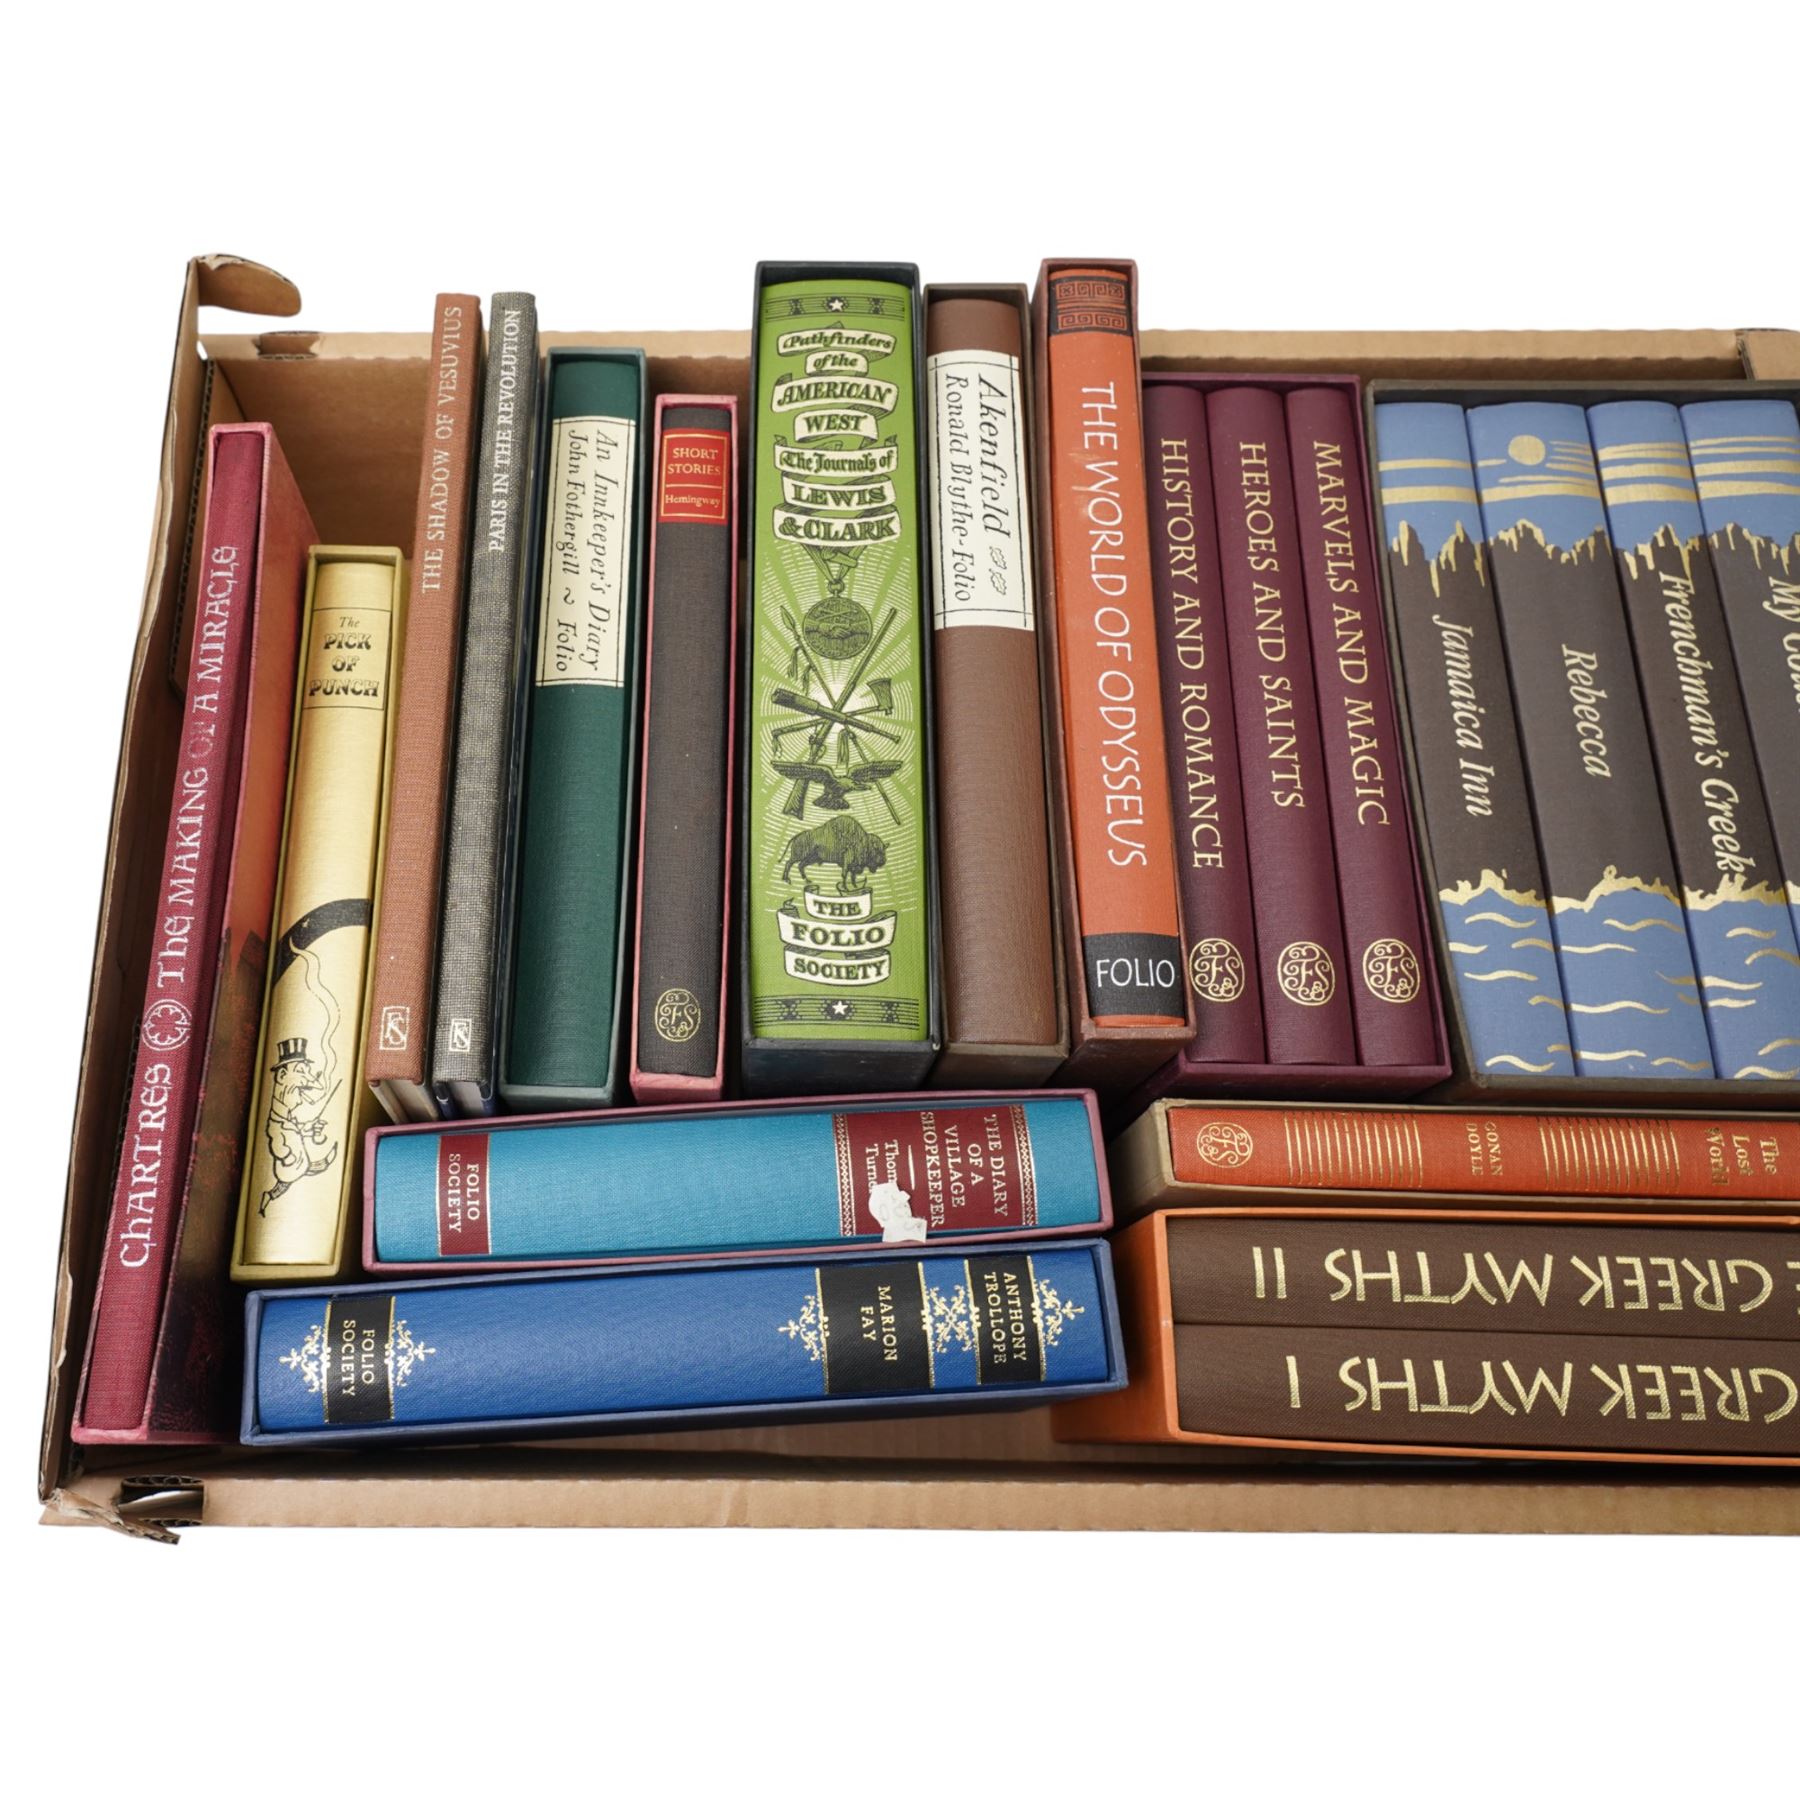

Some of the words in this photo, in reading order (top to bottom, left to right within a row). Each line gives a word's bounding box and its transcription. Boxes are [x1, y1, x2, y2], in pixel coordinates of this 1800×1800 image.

[438, 306, 463, 406] VESUVIUS
[497, 309, 521, 428] REVOLUTION
[782, 331, 892, 350] Pathfinders
[813, 355, 831, 370] of
[829, 354, 858, 367] the
[777, 381, 892, 407] AMERICAN
[945, 374, 970, 455] Ronald
[1081, 381, 1118, 450] THE
[436, 417, 455, 441] OF
[494, 429, 512, 468] THE
[597, 430, 618, 462] An
[802, 414, 868, 432] WEST
[568, 429, 588, 474] John
[667, 464, 721, 476] STORIES
[673, 448, 718, 460] SHORT
[780, 449, 812, 470] The
[813, 451, 877, 474] Journals
[879, 448, 893, 468] of
[978, 373, 1011, 538] Akenfield
[427, 448, 451, 541] SHADOW
[492, 472, 509, 495] IN
[665, 494, 720, 508] Hemingway
[792, 484, 886, 506] LEWIS
[1161, 438, 1198, 584] HISTORY
[1240, 441, 1280, 572] HEROES
[489, 500, 508, 552] PARIS
[556, 479, 586, 576] Fothergill
[587, 470, 619, 594] Innkeeper's
[1085, 461, 1127, 596] WORLD
[1313, 441, 1359, 593] MARVELS
[422, 548, 443, 594] THE
[197, 546, 239, 682] MIRACLE
[323, 632, 372, 650] PICK
[339, 616, 360, 628] The
[579, 600, 611, 671] Diary
[1094, 607, 1132, 661] OF
[1173, 592, 1205, 670] AND
[1253, 581, 1286, 662] AND
[332, 655, 360, 672] OF
[556, 619, 577, 672] Folio
[1332, 603, 1368, 685] AND
[192, 691, 219, 713] A
[309, 679, 379, 697] PUNCH
[1432, 614, 1485, 750] Jamaica
[1459, 757, 1495, 817] Inn
[1561, 643, 1612, 778] Rebecca
[1258, 674, 1306, 808] SAINTS
[1659, 570, 1731, 769] Frenchman's
[1700, 778, 1756, 874] Creek
[1098, 670, 1147, 866] ODYSSEUS
[1180, 682, 1225, 869] ROMANCE
[1344, 696, 1391, 826] MAGIC
[168, 767, 210, 906] MAKING
[791, 922, 885, 946] FOLIO
[813, 900, 861, 917] THE
[794, 959, 886, 980] SOCIETY
[1096, 958, 1175, 988] FOLIO
[967, 1143, 983, 1168] OF
[984, 1114, 1002, 1151] THE
[1465, 1123, 1484, 1176] DOYLE
[1484, 1121, 1503, 1176] CONAN
[1705, 1127, 1730, 1186] World
[1732, 1134, 1754, 1176] Lost
[1760, 1136, 1779, 1175] The
[865, 1143, 879, 1193] Turne
[885, 1139, 899, 1183] Thom
[920, 1112, 945, 1228] SHOPKEEPER
[944, 1125, 966, 1208] VILLAGE
[970, 1172, 984, 1186] A
[990, 1156, 1008, 1216] DIARY
[448, 1153, 461, 1233] SOCIETY
[467, 1163, 480, 1221] FOLIO
[1251, 1246, 1287, 1299] II
[1324, 1248, 1555, 1307] MYTHS
[1570, 1256, 1774, 1313] GREEK
[861, 1305, 876, 1342] FAY
[877, 1286, 898, 1362] MARION
[984, 1271, 1007, 1364] TROLLOPE
[1003, 1272, 1027, 1362] ANTHONY
[341, 1319, 356, 1397] SOCIETY
[362, 1329, 375, 1385] FOLIO
[1286, 1355, 1301, 1409] I
[1339, 1356, 1574, 1417] MYTHS
[1590, 1363, 1798, 1424] GREEK
